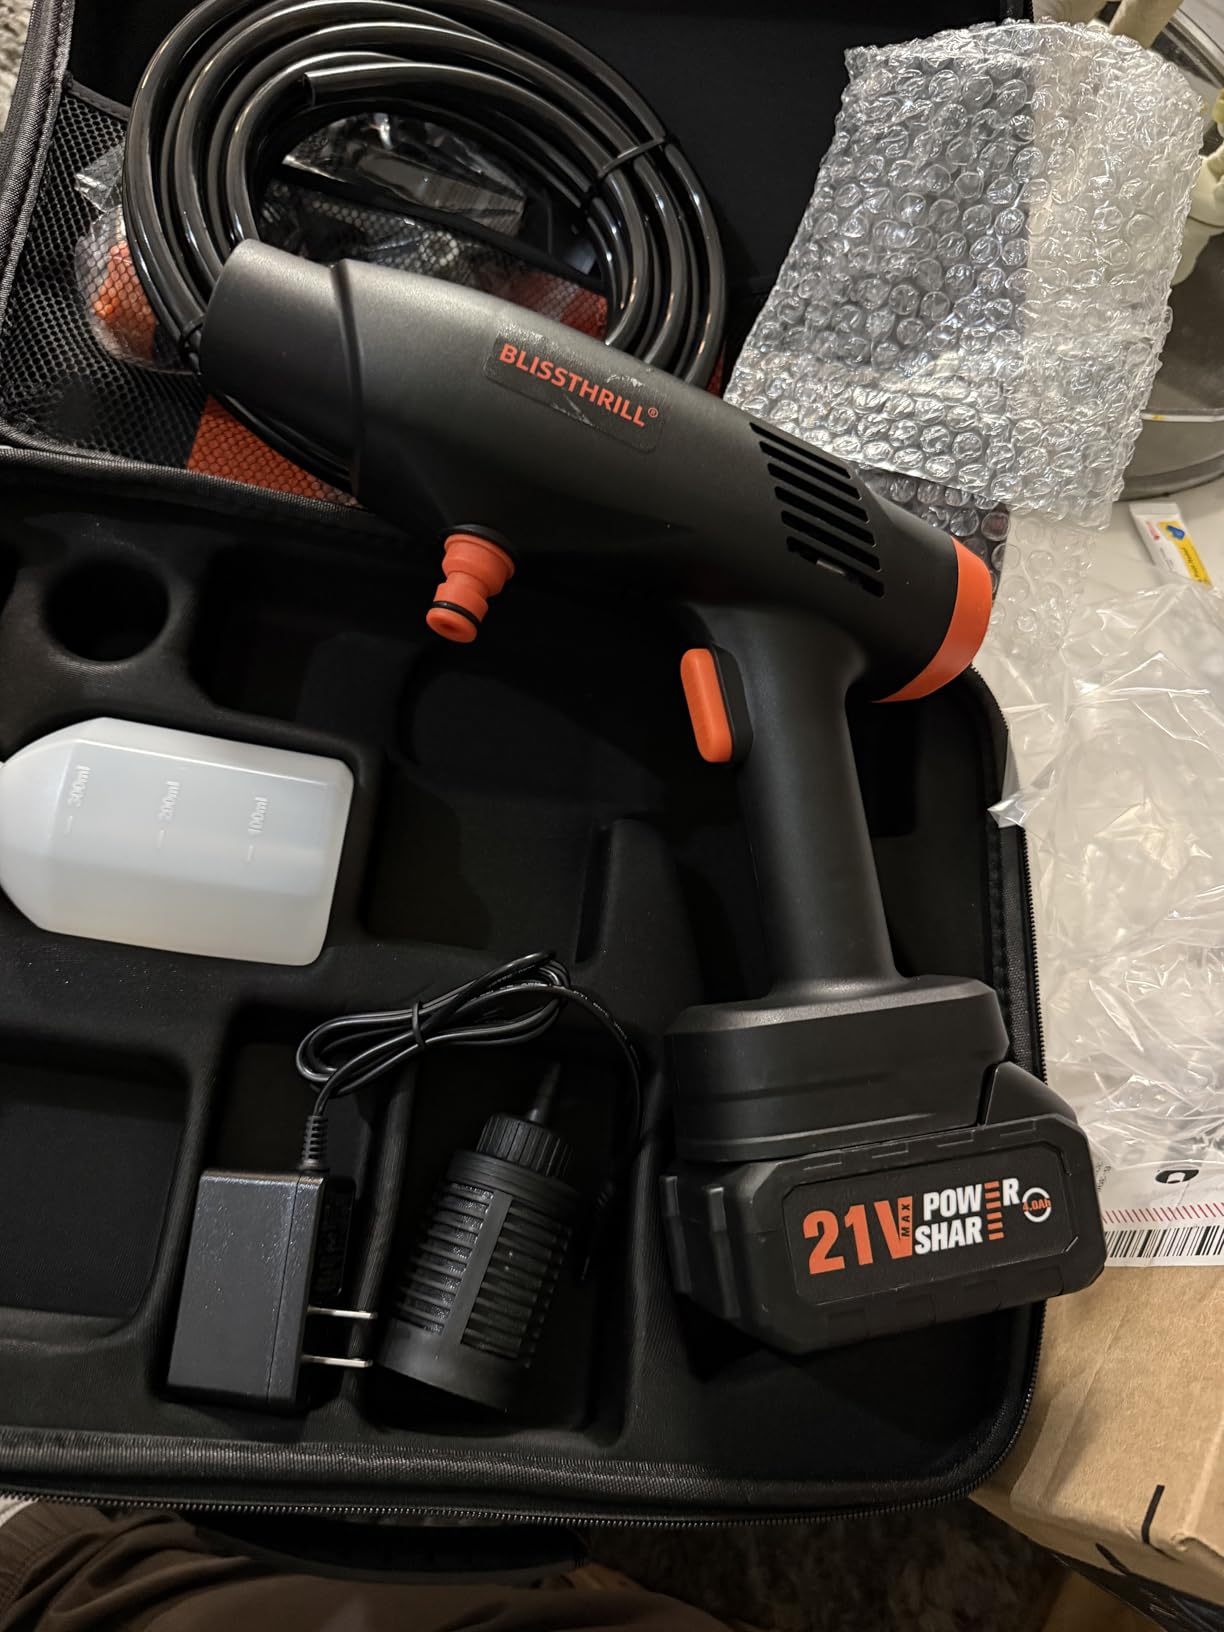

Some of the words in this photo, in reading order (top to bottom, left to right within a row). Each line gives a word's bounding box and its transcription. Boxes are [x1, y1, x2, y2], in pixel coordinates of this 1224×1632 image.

[247, 797, 268, 833] 100ml
[922, 1177, 1020, 1222] POWER
[802, 1195, 913, 1276] 21V
[900, 1203, 910, 1237] MAX
